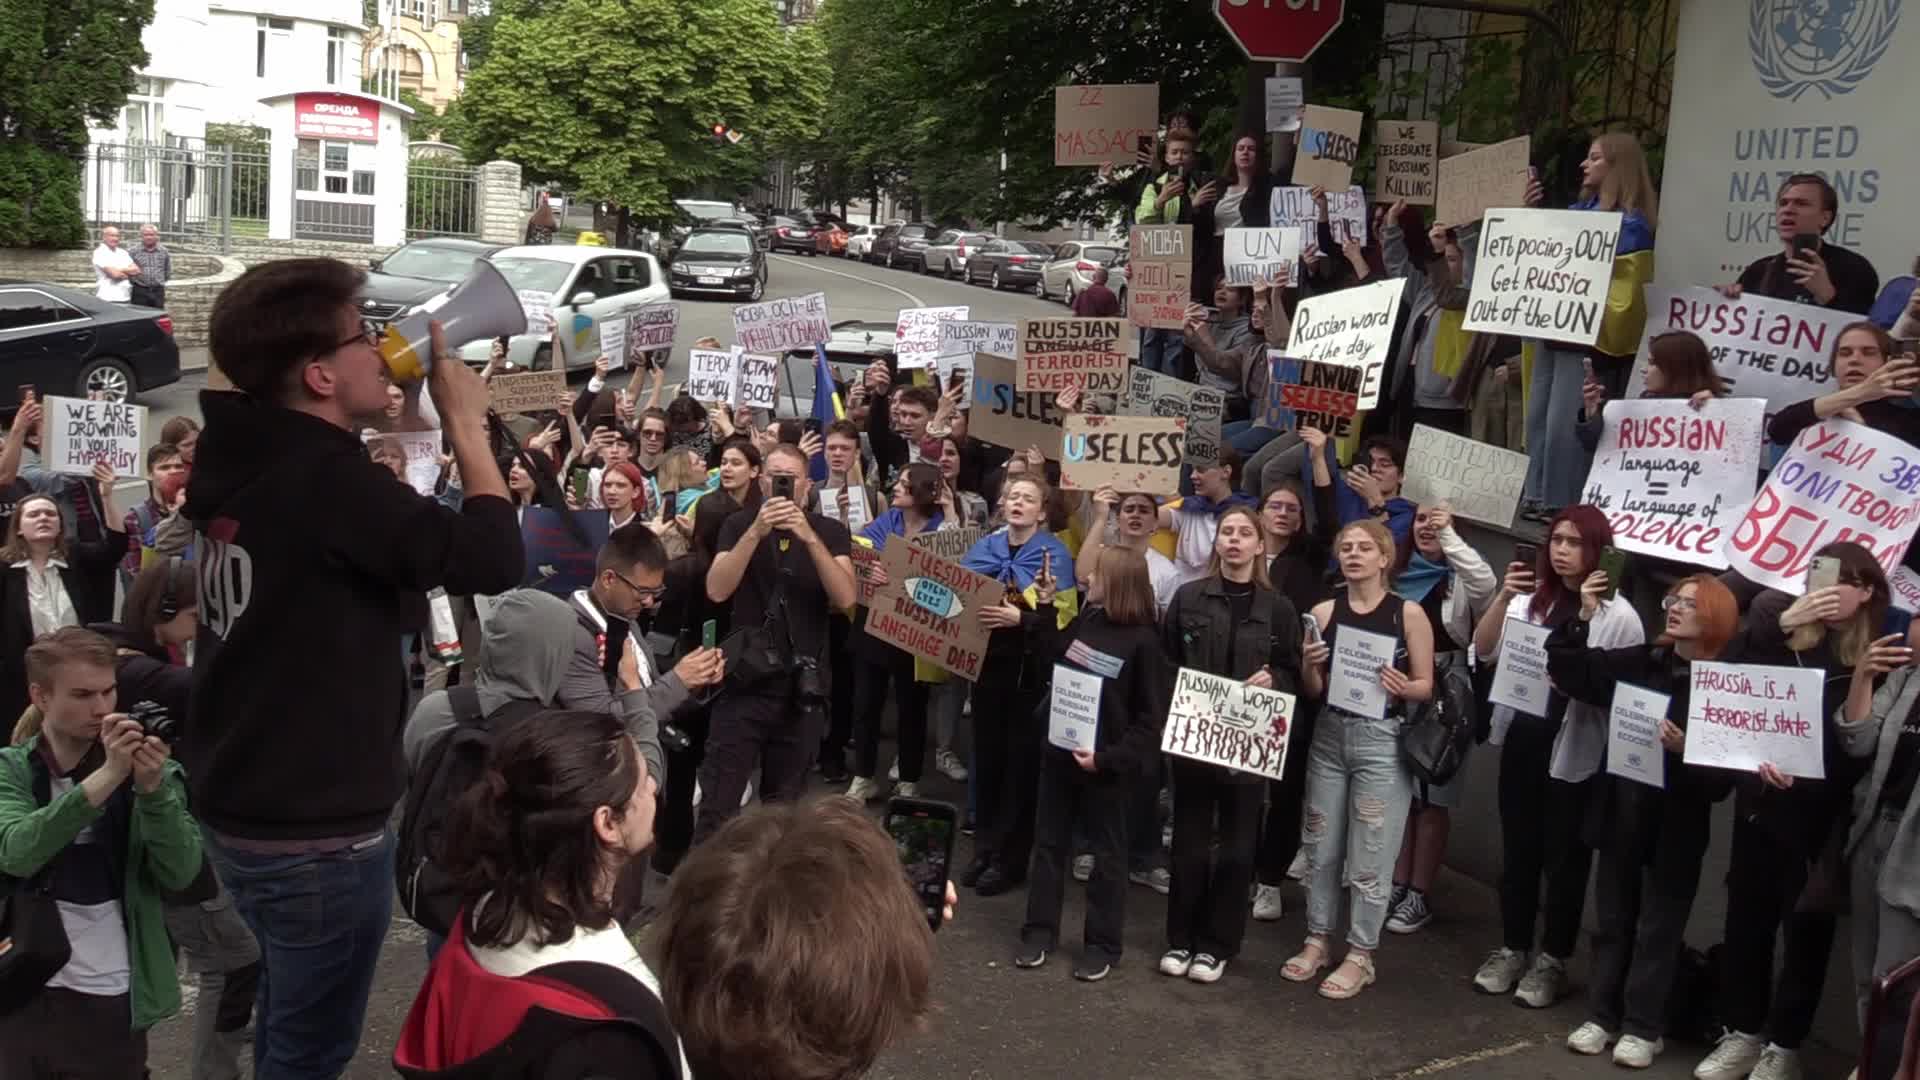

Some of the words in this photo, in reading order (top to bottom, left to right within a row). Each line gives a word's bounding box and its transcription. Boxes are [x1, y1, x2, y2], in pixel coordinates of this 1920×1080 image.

[1398, 126, 1415, 139] WE
[1735, 126, 1859, 160] UNITED
[1378, 143, 1432, 157] CELEBRATE
[1384, 175, 1432, 197] KILLING
[1244, 231, 1282, 258] UN
[1483, 217, 1514, 258] Геть
[1574, 229, 1617, 264] ООН
[1491, 264, 1520, 292] Get
[1293, 307, 1347, 347] Russian
[1351, 295, 1393, 329] word
[1502, 295, 1527, 325] of
[1524, 297, 1552, 328] the
[1554, 300, 1598, 335] UN
[945, 323, 990, 340] RUSSIAN
[997, 327, 1018, 341] WO
[1027, 321, 1120, 339] RUSSIAN
[963, 340, 987, 352] THE
[994, 341, 1015, 352] DAY
[1319, 339, 1340, 361] the
[1346, 332, 1376, 361] day
[1024, 352, 1126, 370] TERRORIST
[1711, 346, 1731, 363] OF
[1735, 349, 1778, 373] THE
[1782, 357, 1830, 385] DAY
[1026, 372, 1123, 391] EVERYDAY
[66, 404, 97, 421] WE
[103, 404, 135, 425] ARE
[67, 421, 138, 438] DROWNING
[69, 437, 81, 450] IN
[87, 438, 118, 453] YOUR
[1063, 431, 1184, 468] USELESS
[1619, 452, 1702, 488] language
[1588, 484, 1612, 509] the
[1622, 490, 1697, 526] language
[1701, 493, 1722, 527] of
[907, 546, 986, 594] TUESDAY
[896, 596, 961, 640] RUSSIAN
[870, 609, 944, 657] LANGUAGE
[1358, 641, 1372, 651] WE
[1505, 640, 1546, 658] CELEBRAT
[1055, 687, 1096, 704] CELEBRATE
[1178, 671, 1232, 705] RUSSIAN
[1243, 688, 1287, 722] WORD
